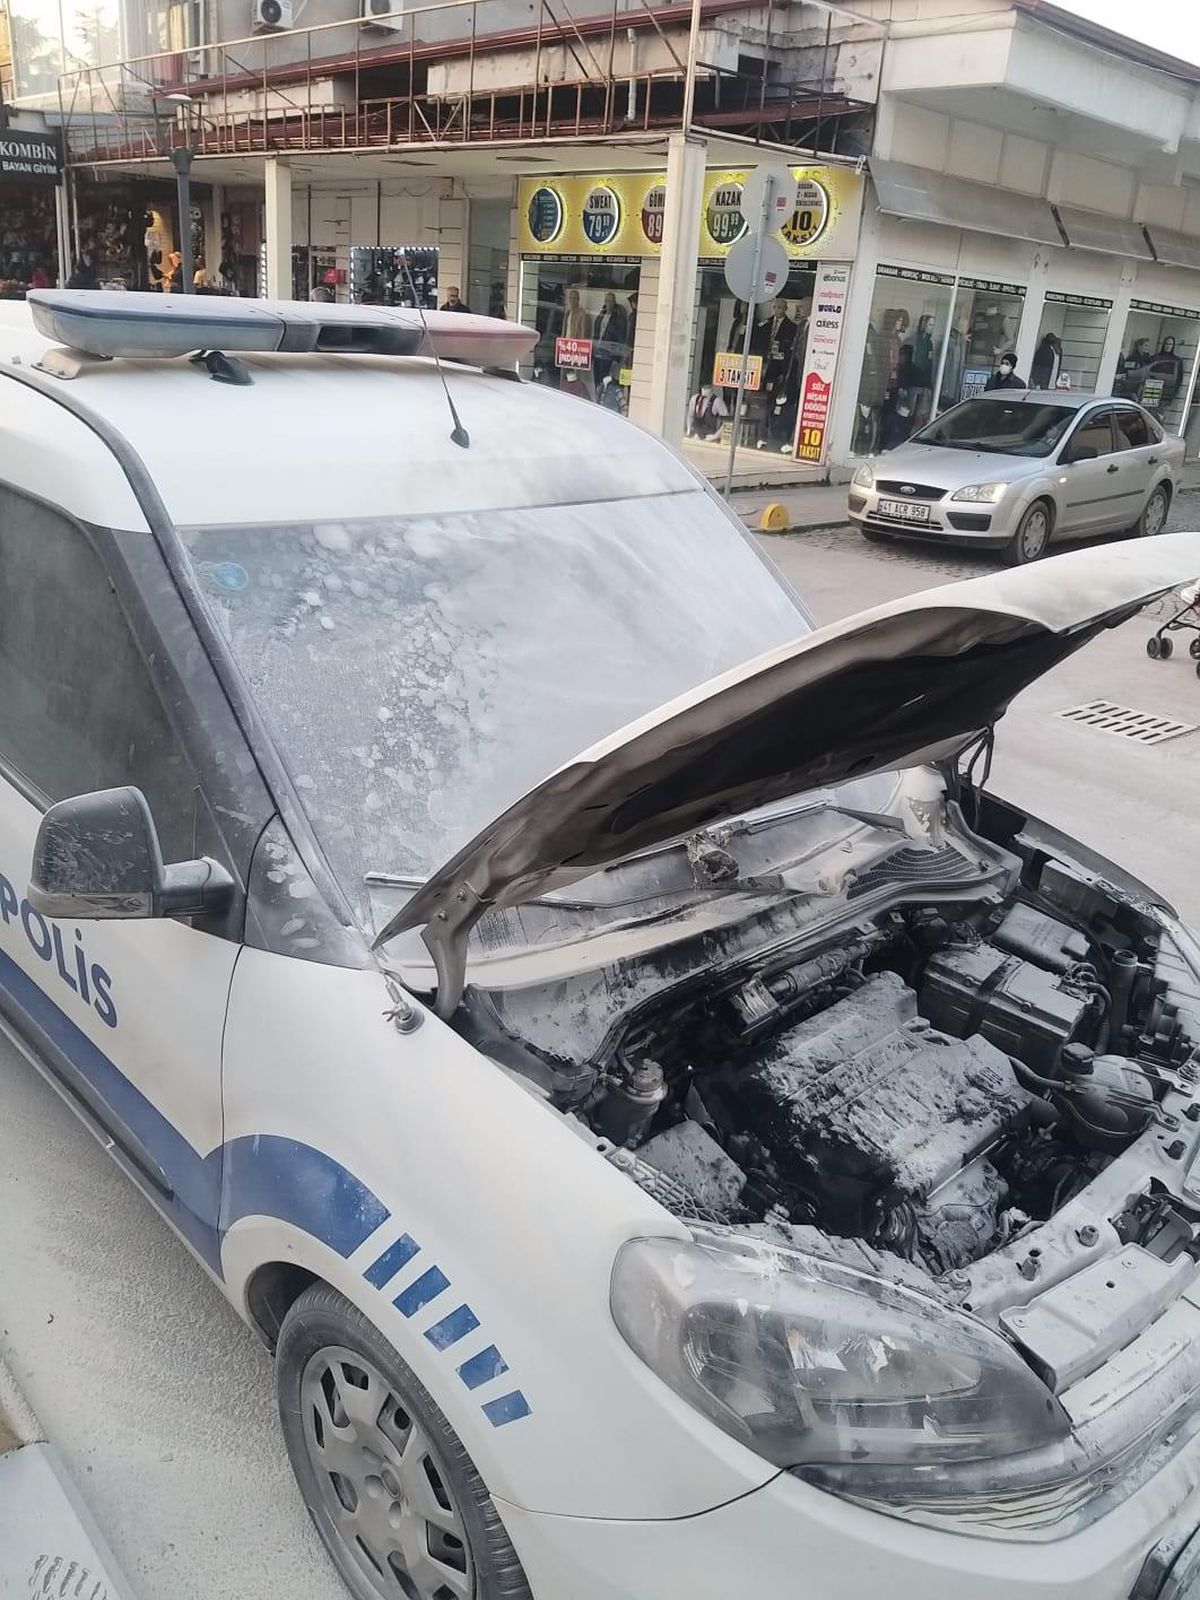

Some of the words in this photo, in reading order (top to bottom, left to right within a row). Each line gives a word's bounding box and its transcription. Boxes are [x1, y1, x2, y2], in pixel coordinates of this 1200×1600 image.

[2, 160, 32, 172] BAYAN
[589, 194, 612, 209] SWEAT
[715, 190, 741, 206] KAZAK
[791, 211, 812, 231] 10
[818, 304, 842, 313] WORLD
[816, 320, 840, 329] axess
[803, 428, 821, 446] 10
[911, 506, 926, 518] 958
